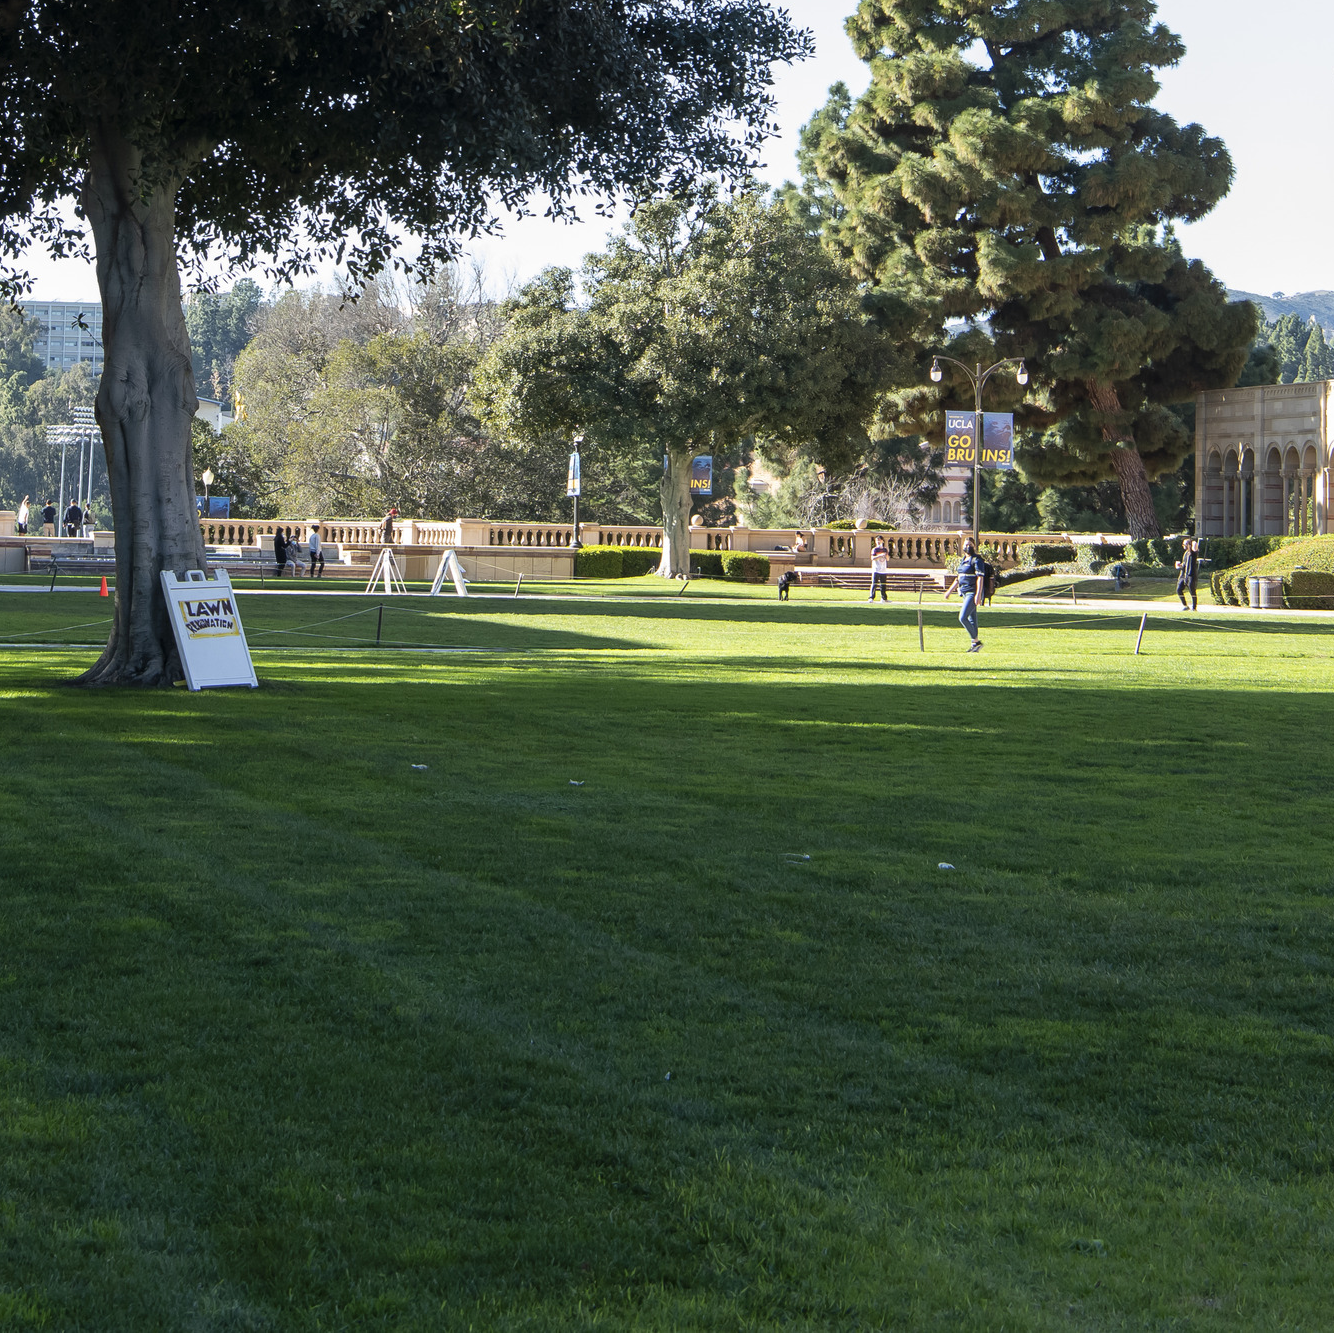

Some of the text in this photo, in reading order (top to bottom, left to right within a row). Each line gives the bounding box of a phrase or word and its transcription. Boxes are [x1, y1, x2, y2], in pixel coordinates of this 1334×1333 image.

[949, 419, 973, 429] UCLA
[948, 435, 971, 448] GO
[185, 600, 234, 617] LAWN
